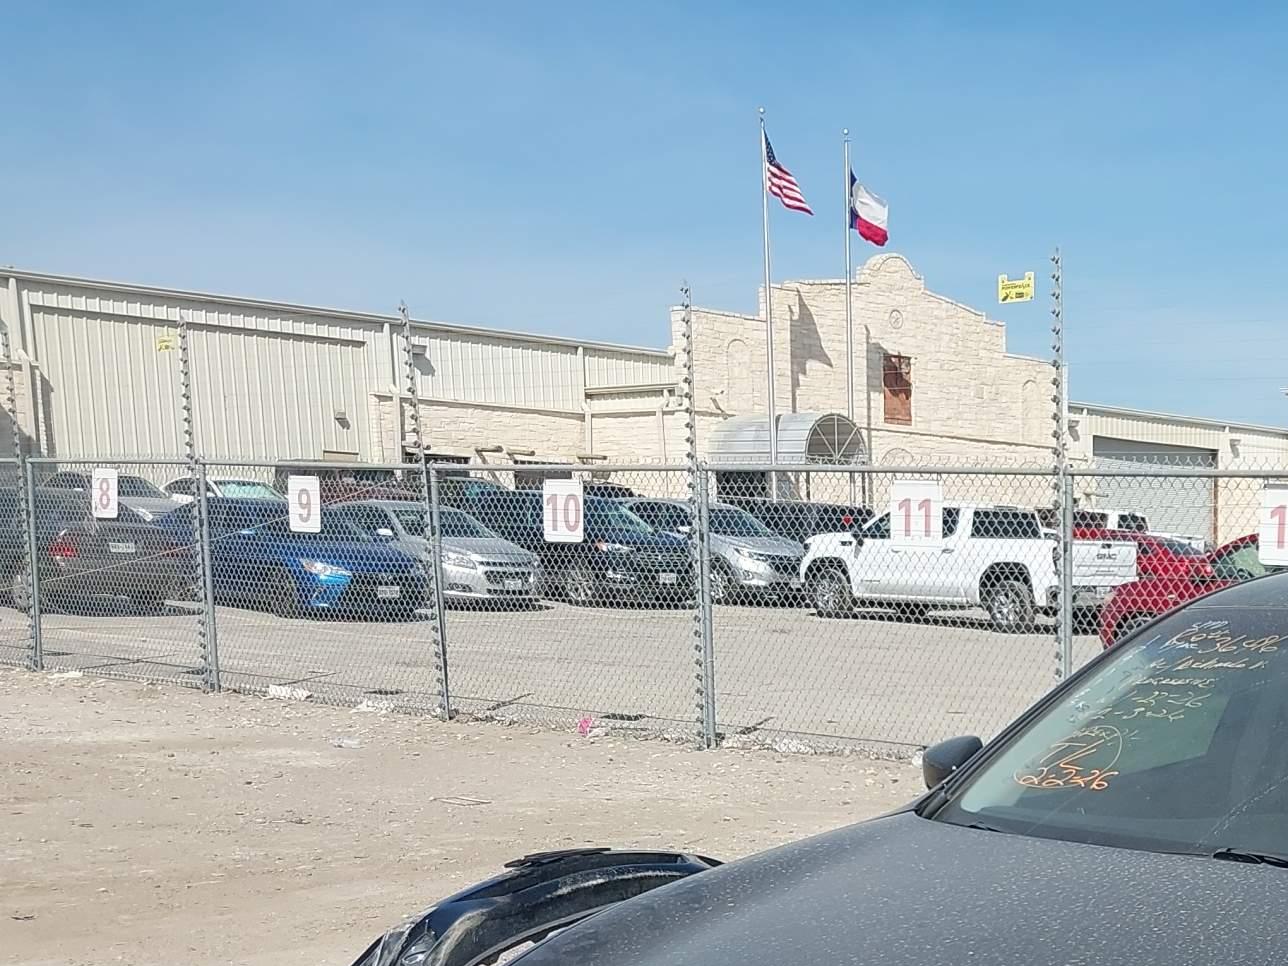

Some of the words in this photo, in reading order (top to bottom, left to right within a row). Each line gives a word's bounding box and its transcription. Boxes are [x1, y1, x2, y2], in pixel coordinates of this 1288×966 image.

[99, 478, 111, 510] 8
[298, 488, 312, 523] 9
[546, 493, 581, 532] 10
[898, 497, 932, 537] 11
